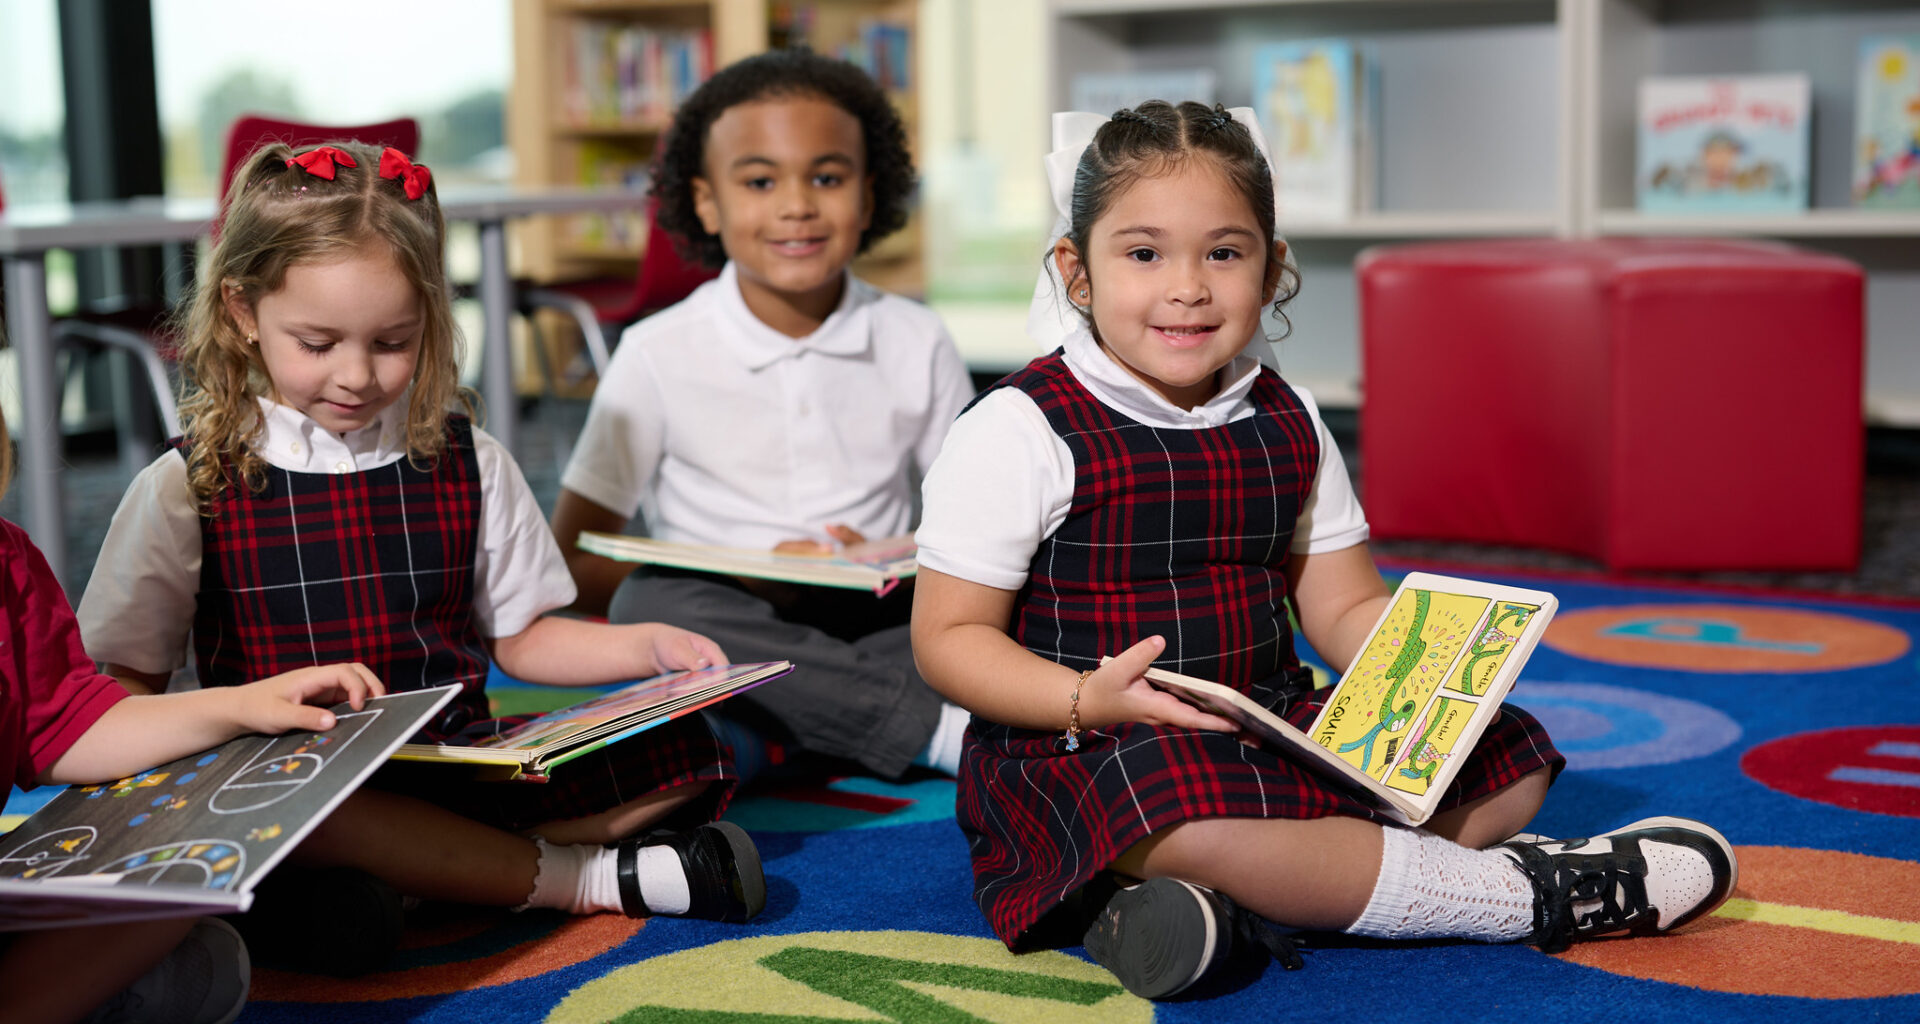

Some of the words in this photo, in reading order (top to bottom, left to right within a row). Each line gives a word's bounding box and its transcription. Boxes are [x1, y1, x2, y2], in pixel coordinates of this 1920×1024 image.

[1477, 661, 1497, 690] Gentle
[1318, 695, 1351, 748] SQUIS
[1435, 709, 1458, 741] Gentle!
